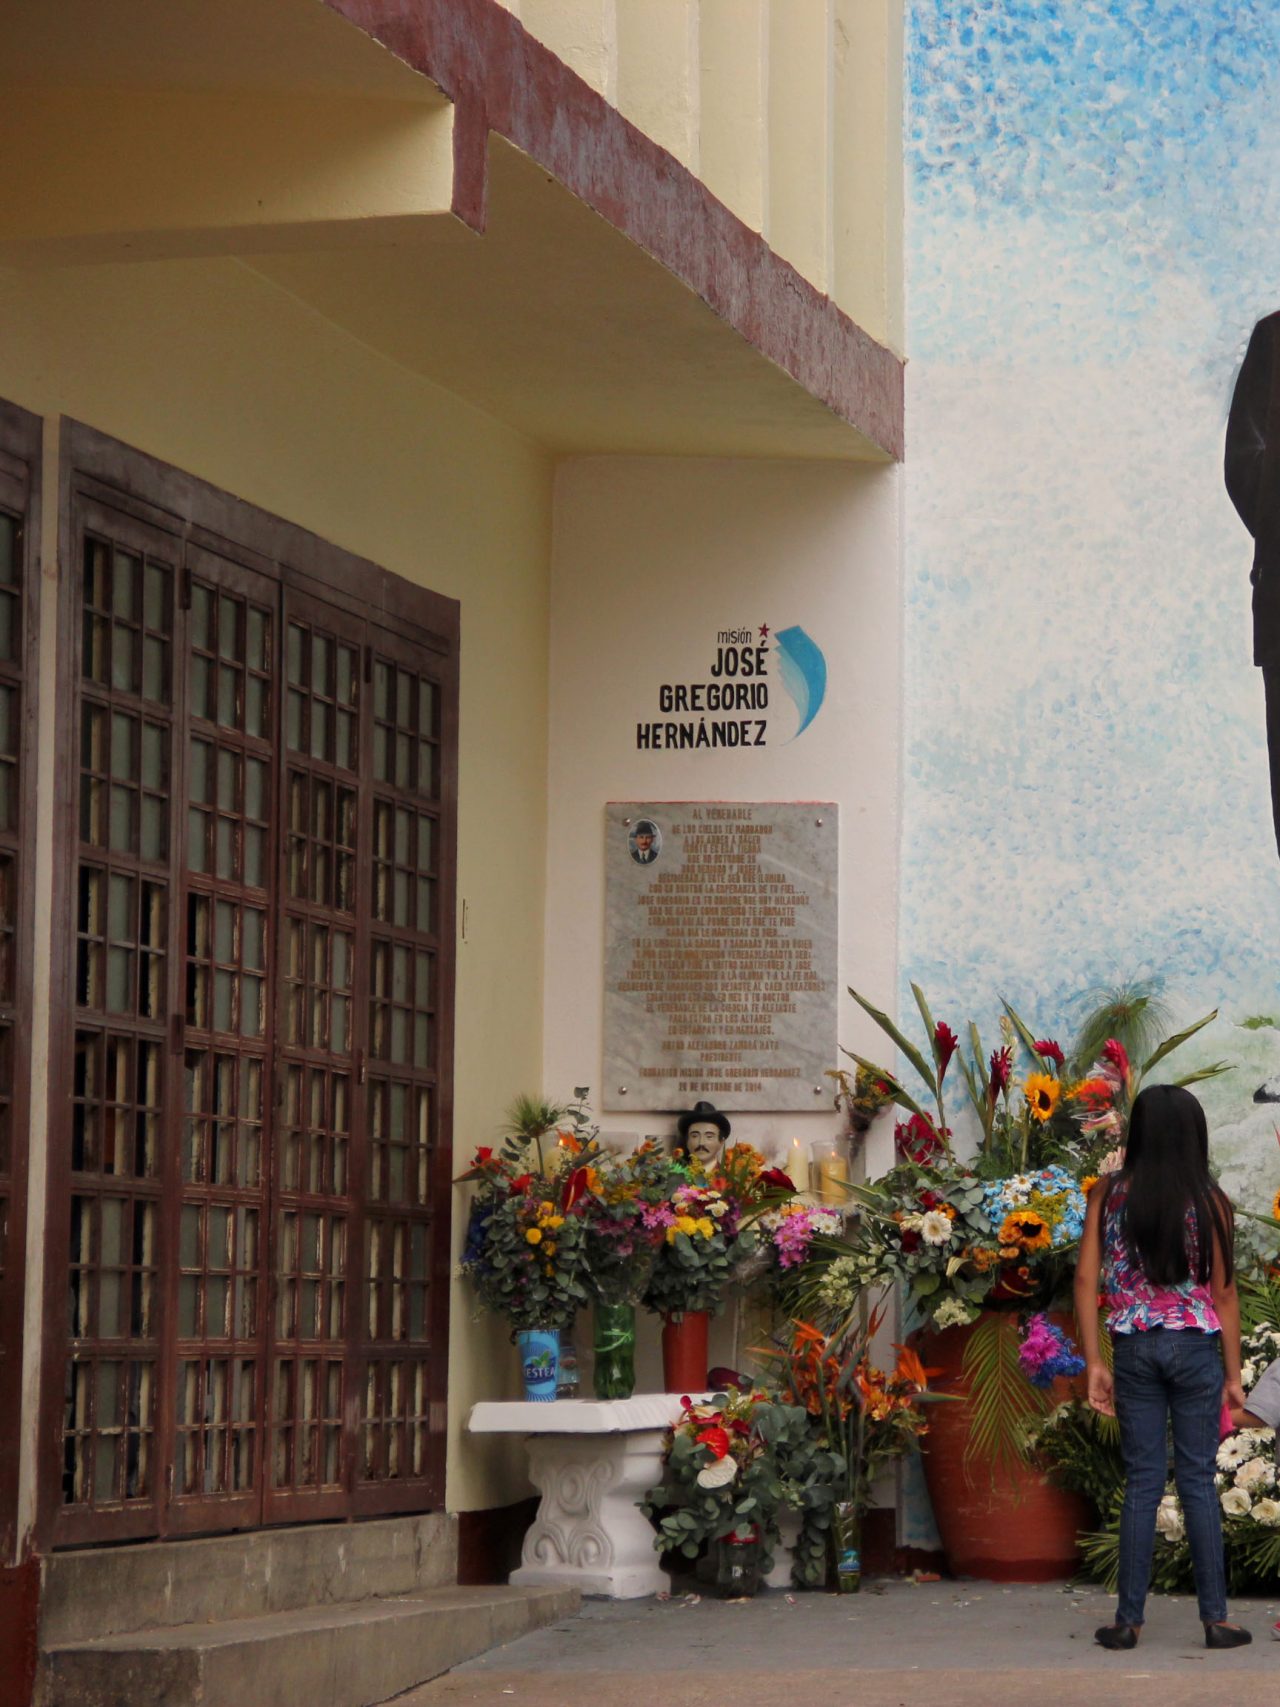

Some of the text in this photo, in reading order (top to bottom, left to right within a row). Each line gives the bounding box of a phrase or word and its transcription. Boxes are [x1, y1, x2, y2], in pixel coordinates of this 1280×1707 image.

[717, 626, 752, 644] misión
[711, 640, 769, 677] JOSÉ
[659, 682, 769, 713] GREGORIO
[636, 717, 767, 749] HERNÁNDEZ
[692, 809, 703, 820] AL
